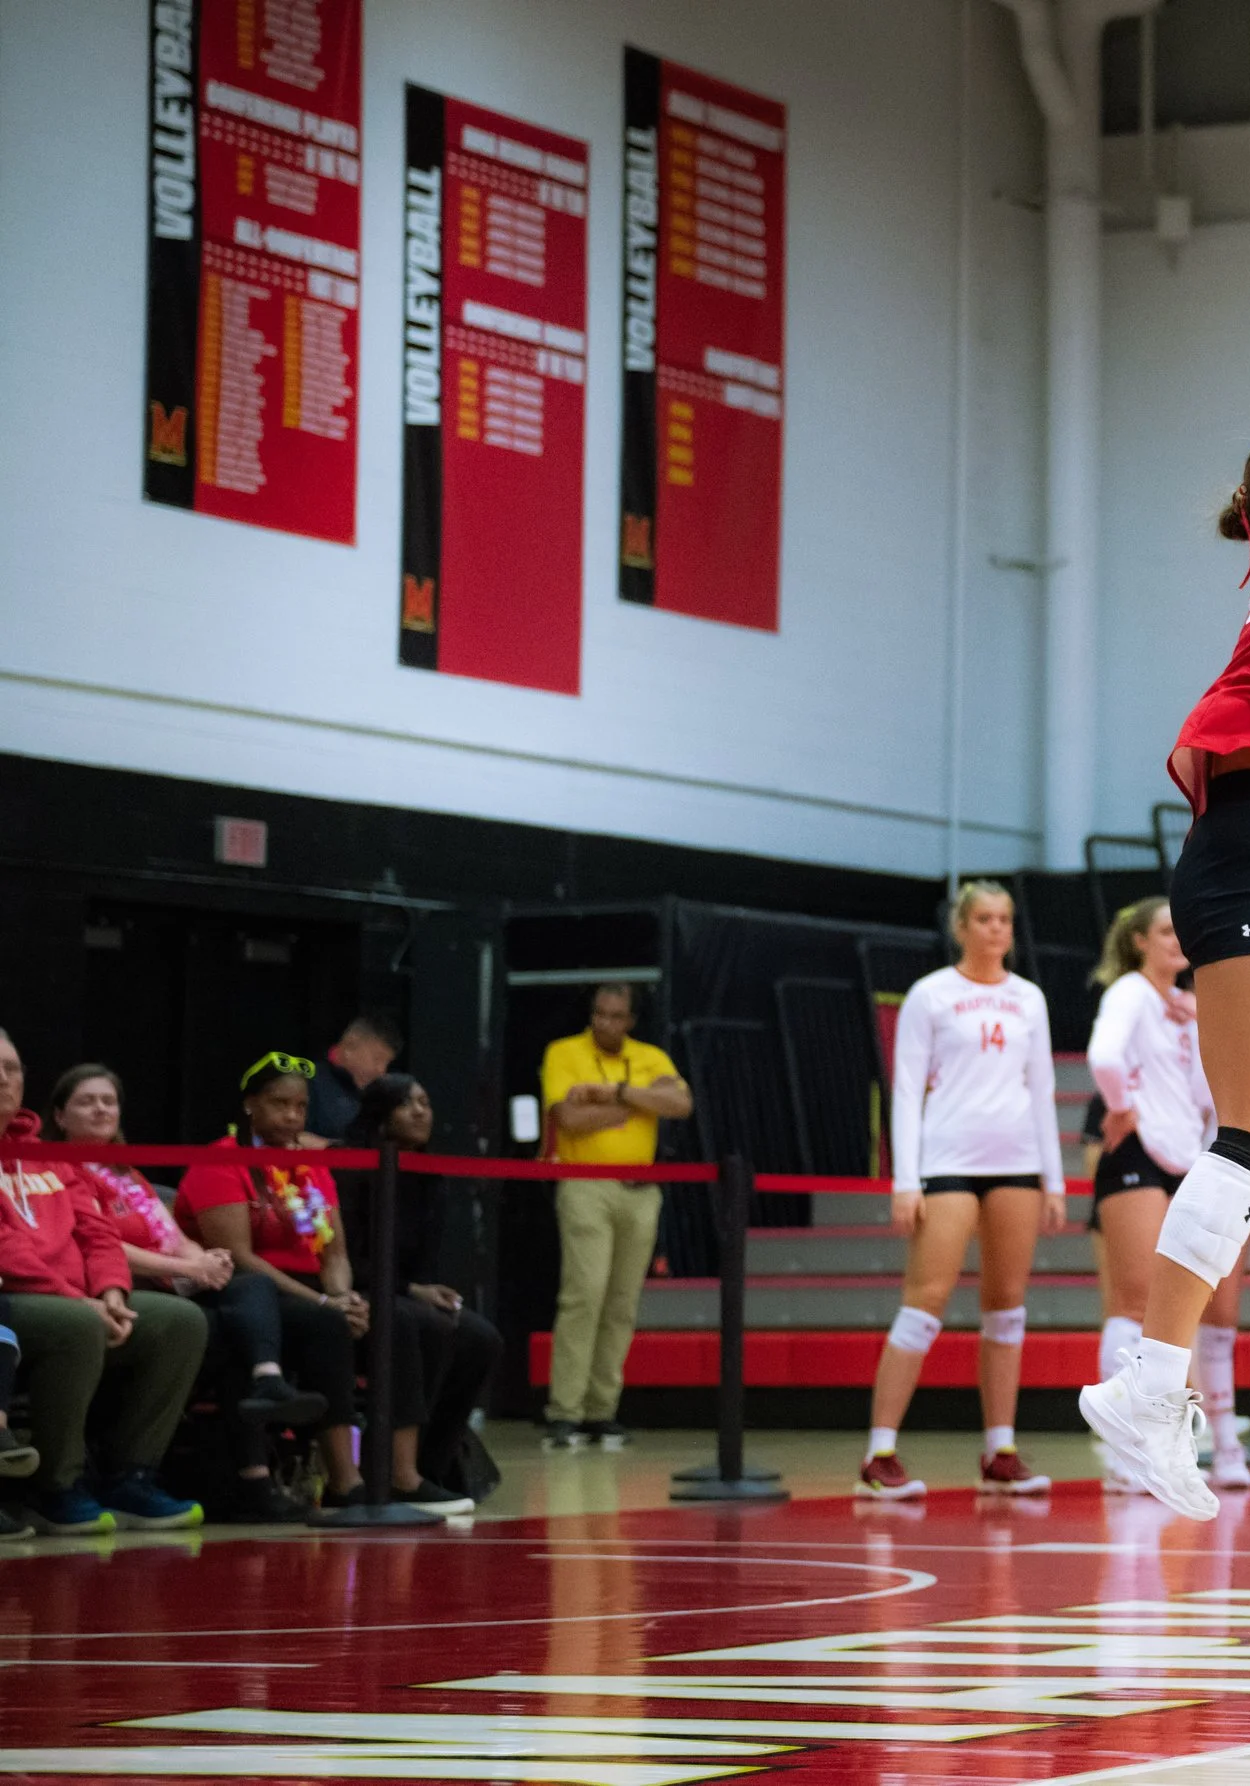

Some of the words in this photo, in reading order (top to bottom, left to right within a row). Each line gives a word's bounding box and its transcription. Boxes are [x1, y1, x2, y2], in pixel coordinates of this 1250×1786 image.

[154, 0, 195, 240] VOLLEYBA
[406, 166, 442, 425] VOLLEYBALL
[980, 1021, 1006, 1054] 14
